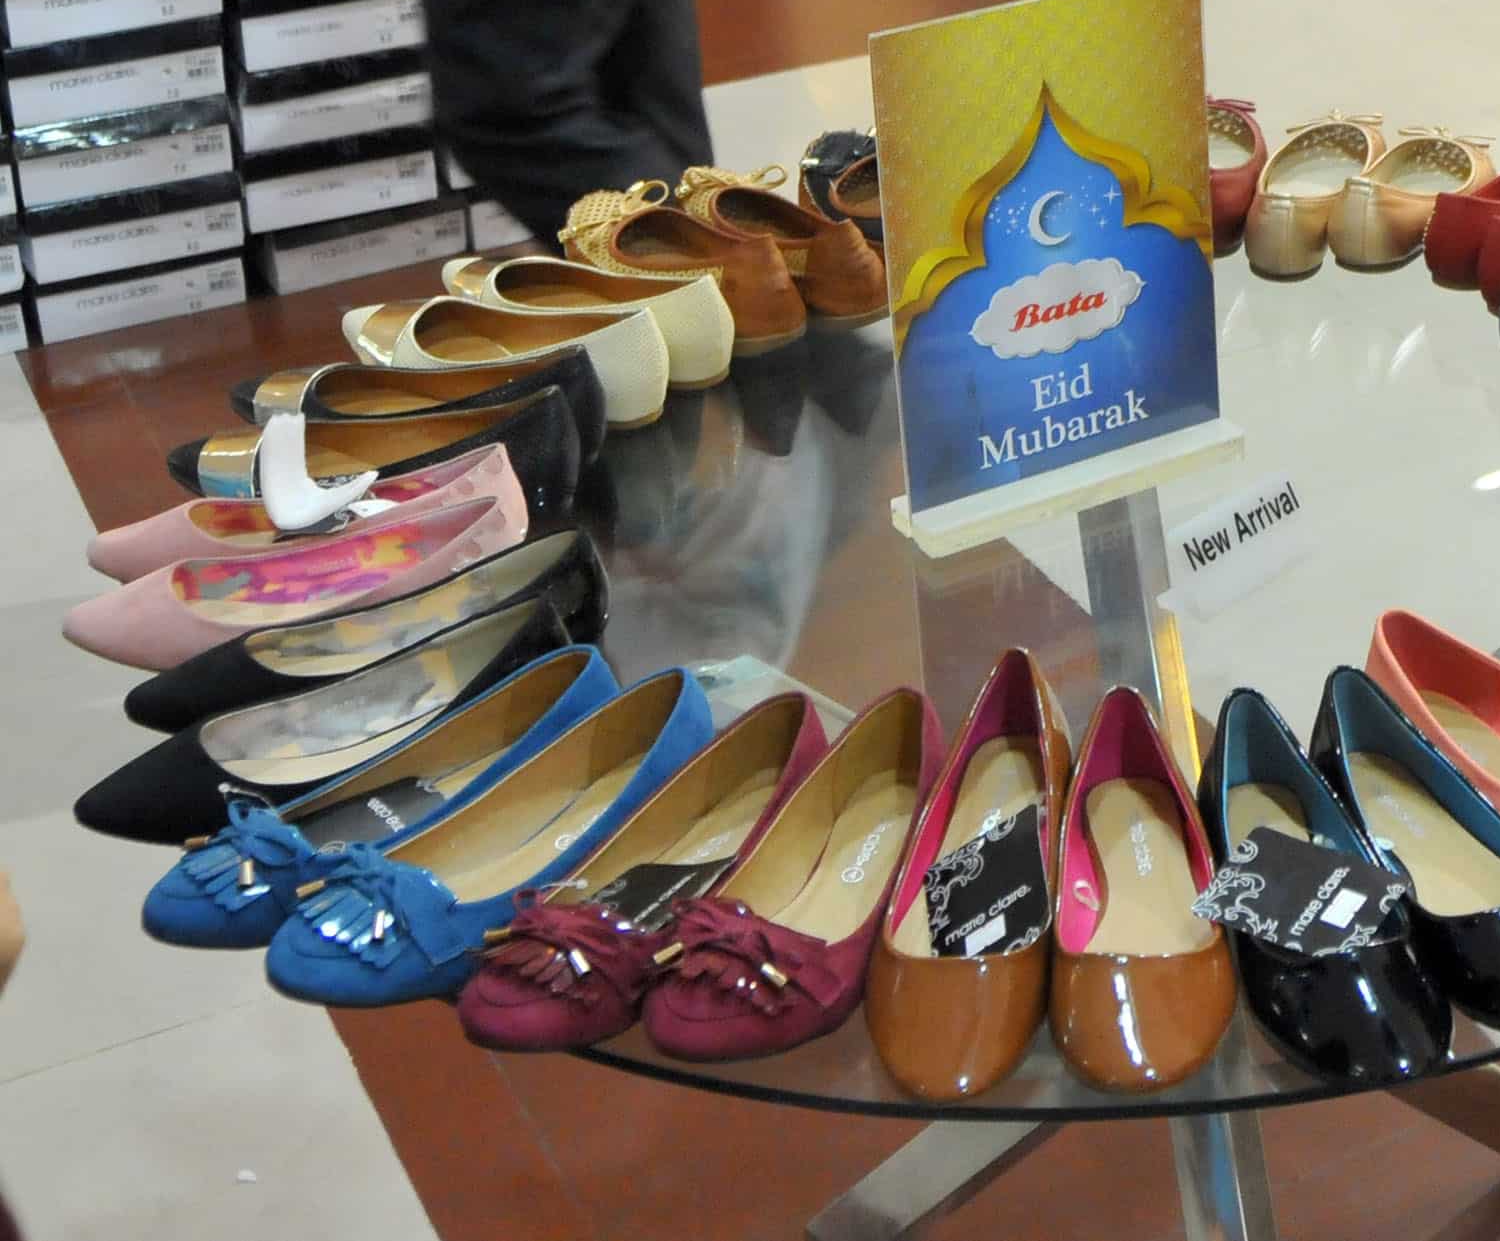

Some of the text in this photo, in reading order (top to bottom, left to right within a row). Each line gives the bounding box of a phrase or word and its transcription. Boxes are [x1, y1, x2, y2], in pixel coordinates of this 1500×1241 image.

[1008, 291, 1108, 334] Bata
[1030, 363, 1094, 412] Eid
[978, 389, 1150, 470] Mubarak
[1182, 480, 1301, 572] New Arrival
[944, 912, 987, 947] marie
[1290, 899, 1322, 937] marie
